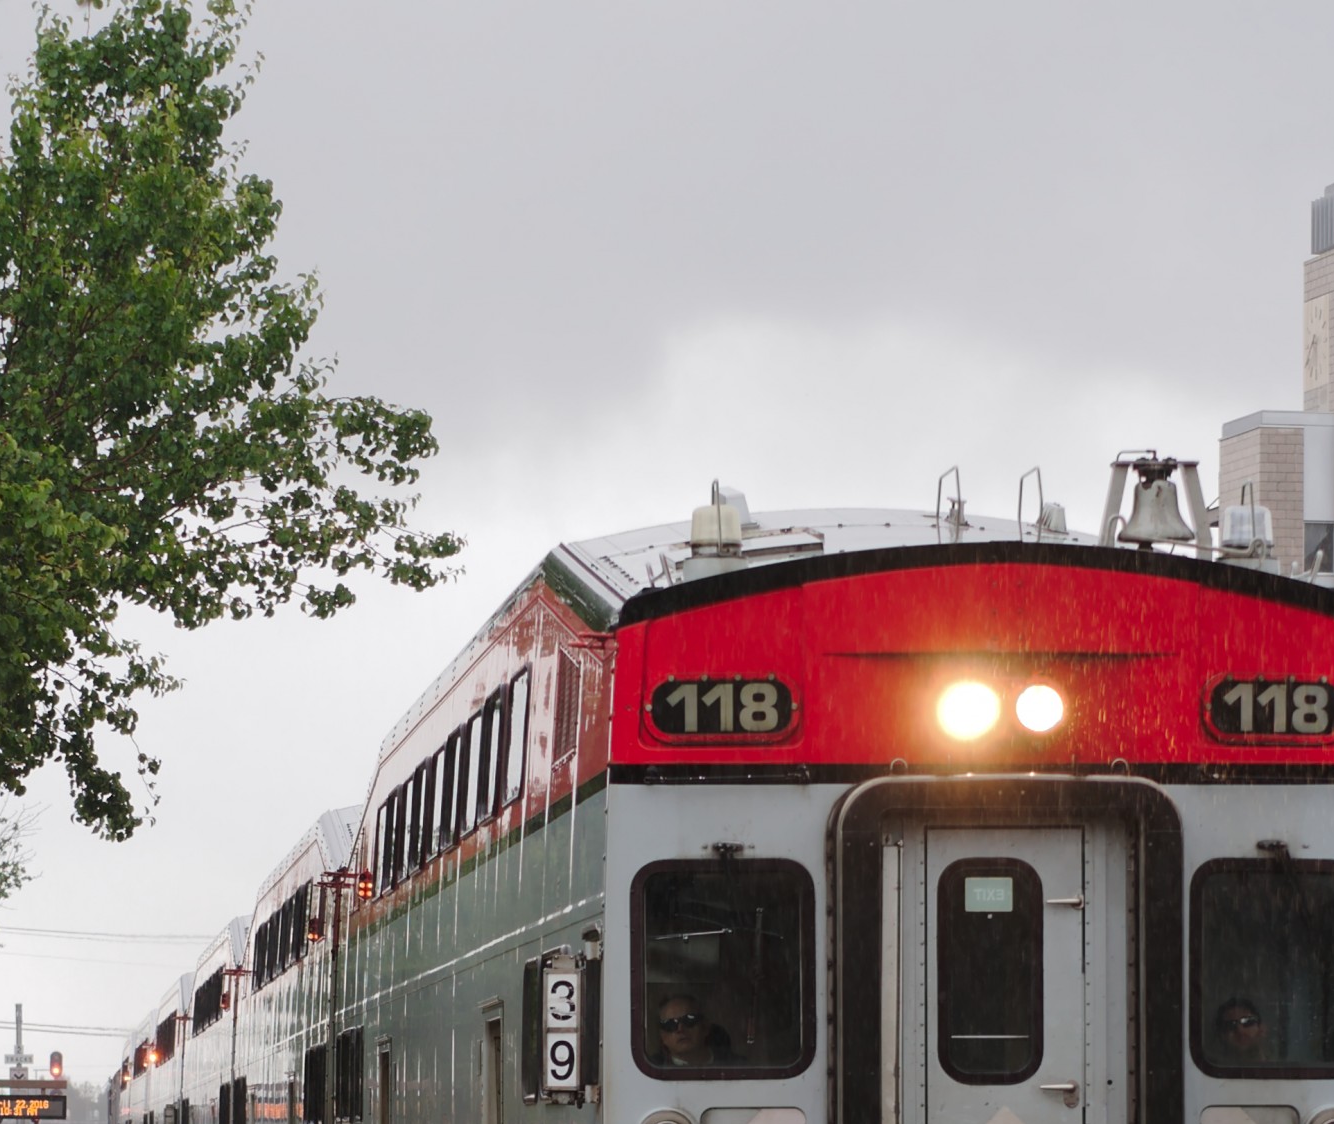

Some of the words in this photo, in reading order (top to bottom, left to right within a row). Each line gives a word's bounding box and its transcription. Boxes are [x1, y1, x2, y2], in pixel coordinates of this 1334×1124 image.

[665, 682, 779, 733] 118
[1223, 682, 1329, 733] 118
[0, 1107, 23, 1116] 10:31
